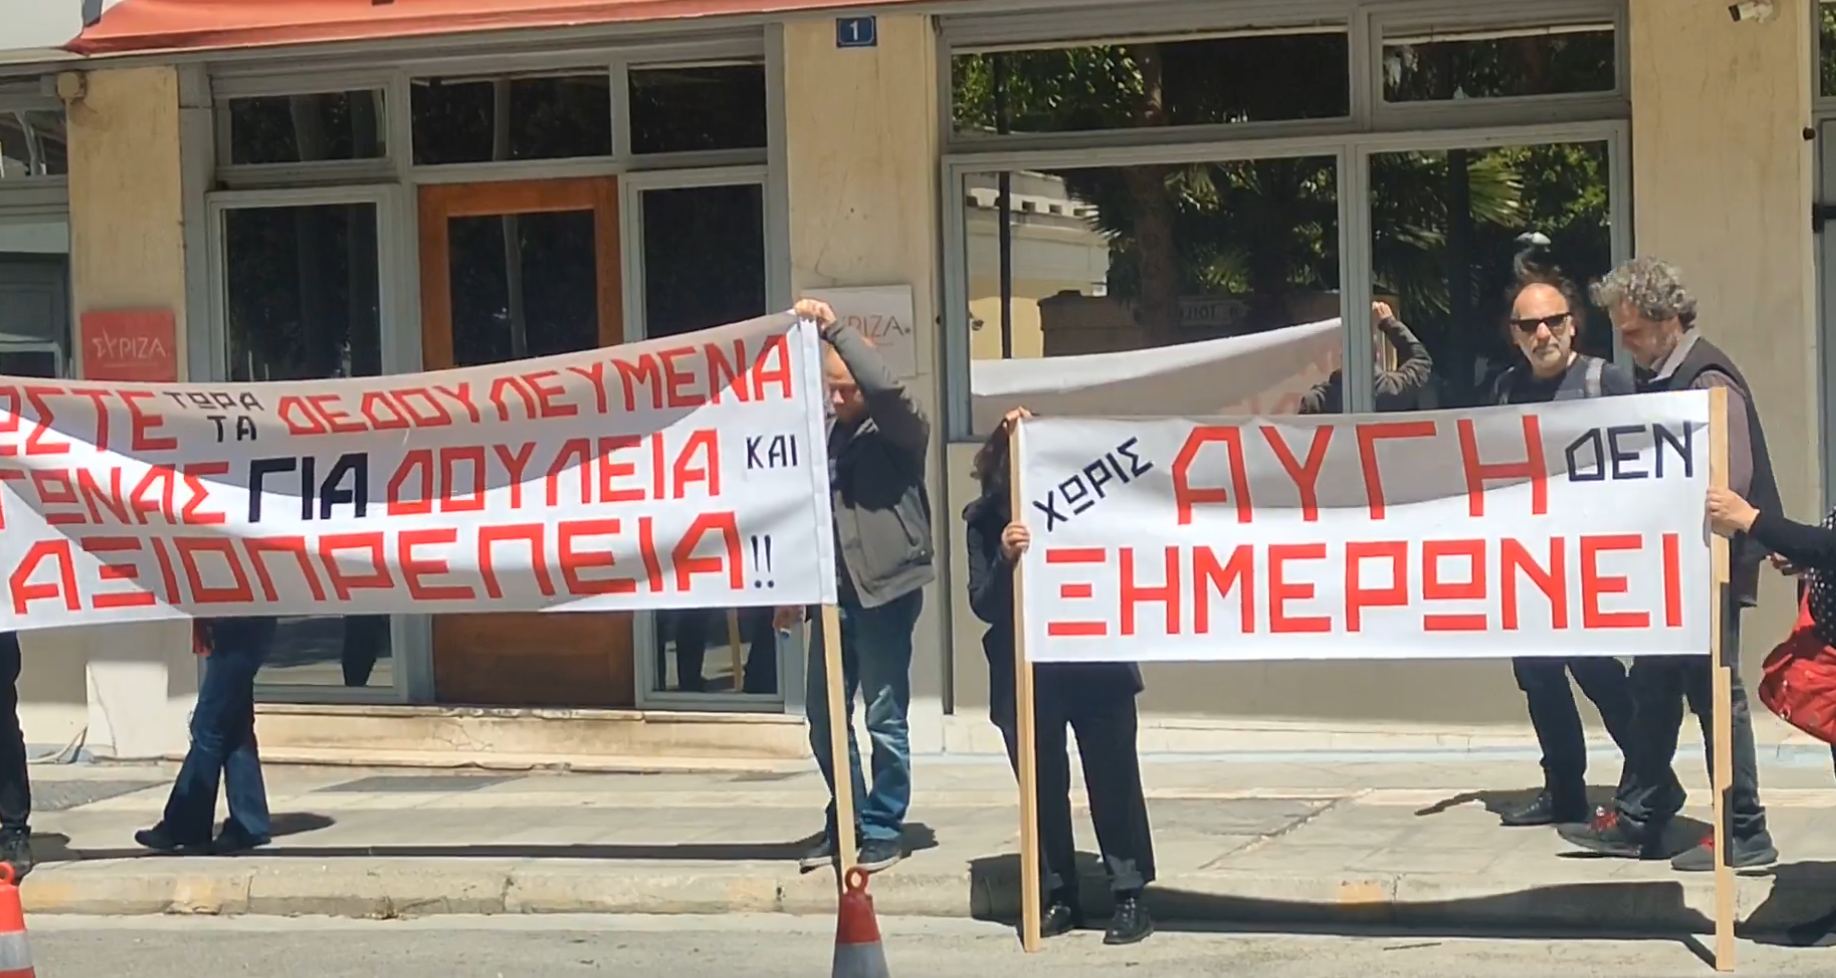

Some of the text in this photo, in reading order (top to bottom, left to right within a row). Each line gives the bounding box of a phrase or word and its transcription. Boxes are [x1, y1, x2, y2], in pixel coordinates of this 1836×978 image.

[849, 20, 859, 42] 1
[92, 326, 167, 359] ΣΥΡΙΖΑ
[163, 390, 266, 412] ΤΩΡΑ
[277, 334, 793, 436] ΔΕΔΟΥΛΕΥΜΕΝΑ
[206, 415, 258, 442] ΤΑ
[248, 452, 369, 523] ΓΙΑ
[386, 428, 721, 516] ΔΟΥΛΕΙΑ
[745, 434, 799, 470] ΚΑΙ
[1032, 413, 1695, 533] ΧΩΡΙΣ ΑΥΓΗ ΔΕΝ
[1044, 532, 1684, 637] ΞΗΜΕΡΩΝΕΙ
